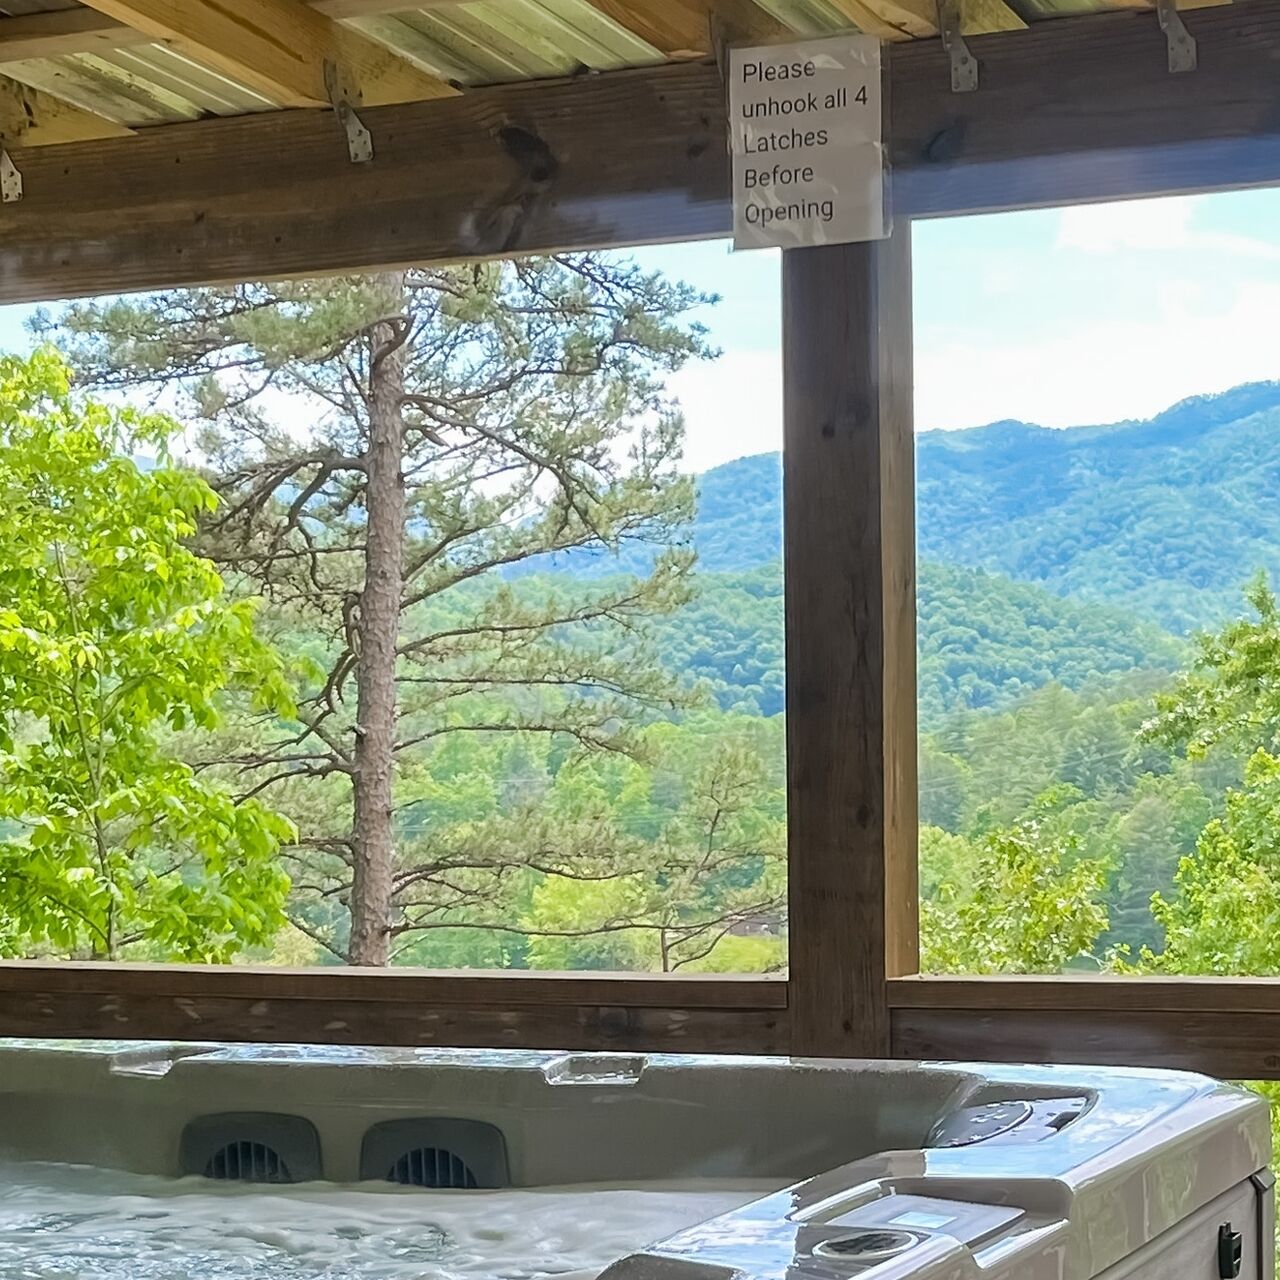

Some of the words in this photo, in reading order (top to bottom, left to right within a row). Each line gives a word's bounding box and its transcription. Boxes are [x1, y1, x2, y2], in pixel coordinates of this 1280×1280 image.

[743, 61, 816, 83] Please
[742, 92, 818, 118] unhook
[824, 88, 846, 109] all
[855, 85, 867, 105] 4
[744, 128, 828, 154] Latches
[744, 165, 814, 188] Before
[745, 199, 834, 227] Opening
